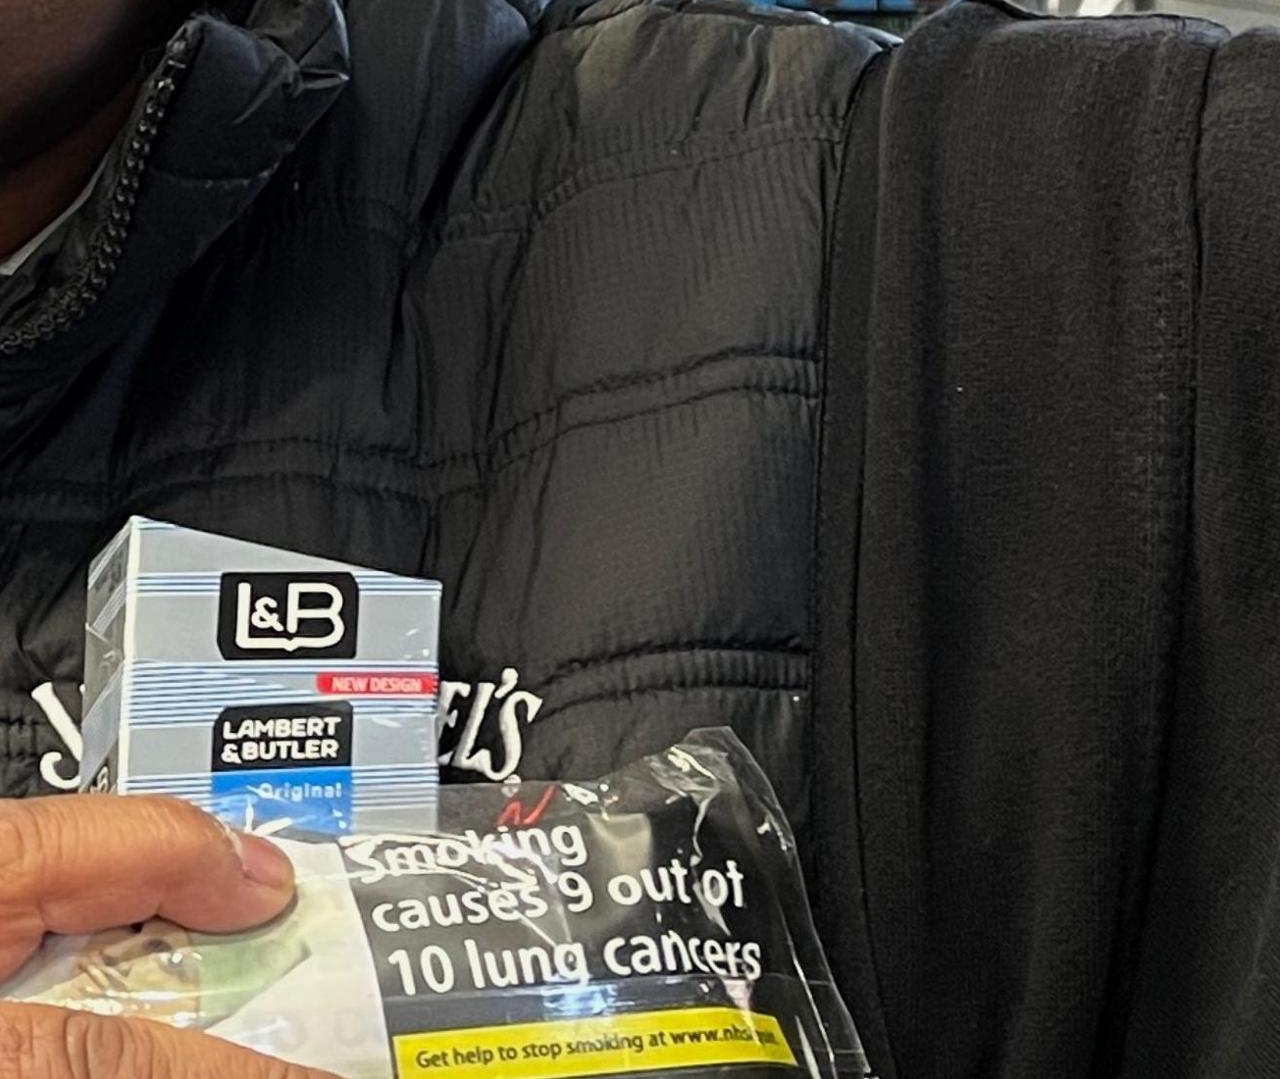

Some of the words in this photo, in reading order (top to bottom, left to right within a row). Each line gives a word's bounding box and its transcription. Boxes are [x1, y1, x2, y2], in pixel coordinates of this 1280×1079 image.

[235, 581, 346, 652] L&B
[331, 676, 366, 693] NEW
[370, 676, 422, 693] DESIGN
[222, 716, 342, 741] LAMBERT
[257, 781, 342, 800] Original
[345, 823, 588, 884] Smoking
[372, 880, 548, 932] causes
[559, 870, 593, 914] 9
[608, 860, 692, 907] out
[387, 945, 454, 996] 10
[465, 939, 590, 988] lung
[604, 929, 761, 979] cancers
[415, 1049, 450, 1070] Get
[455, 1045, 493, 1069] help
[498, 1044, 517, 1062] to
[522, 1041, 562, 1060] stop
[566, 1034, 644, 1057] smoking
[648, 1030, 667, 1047] at
